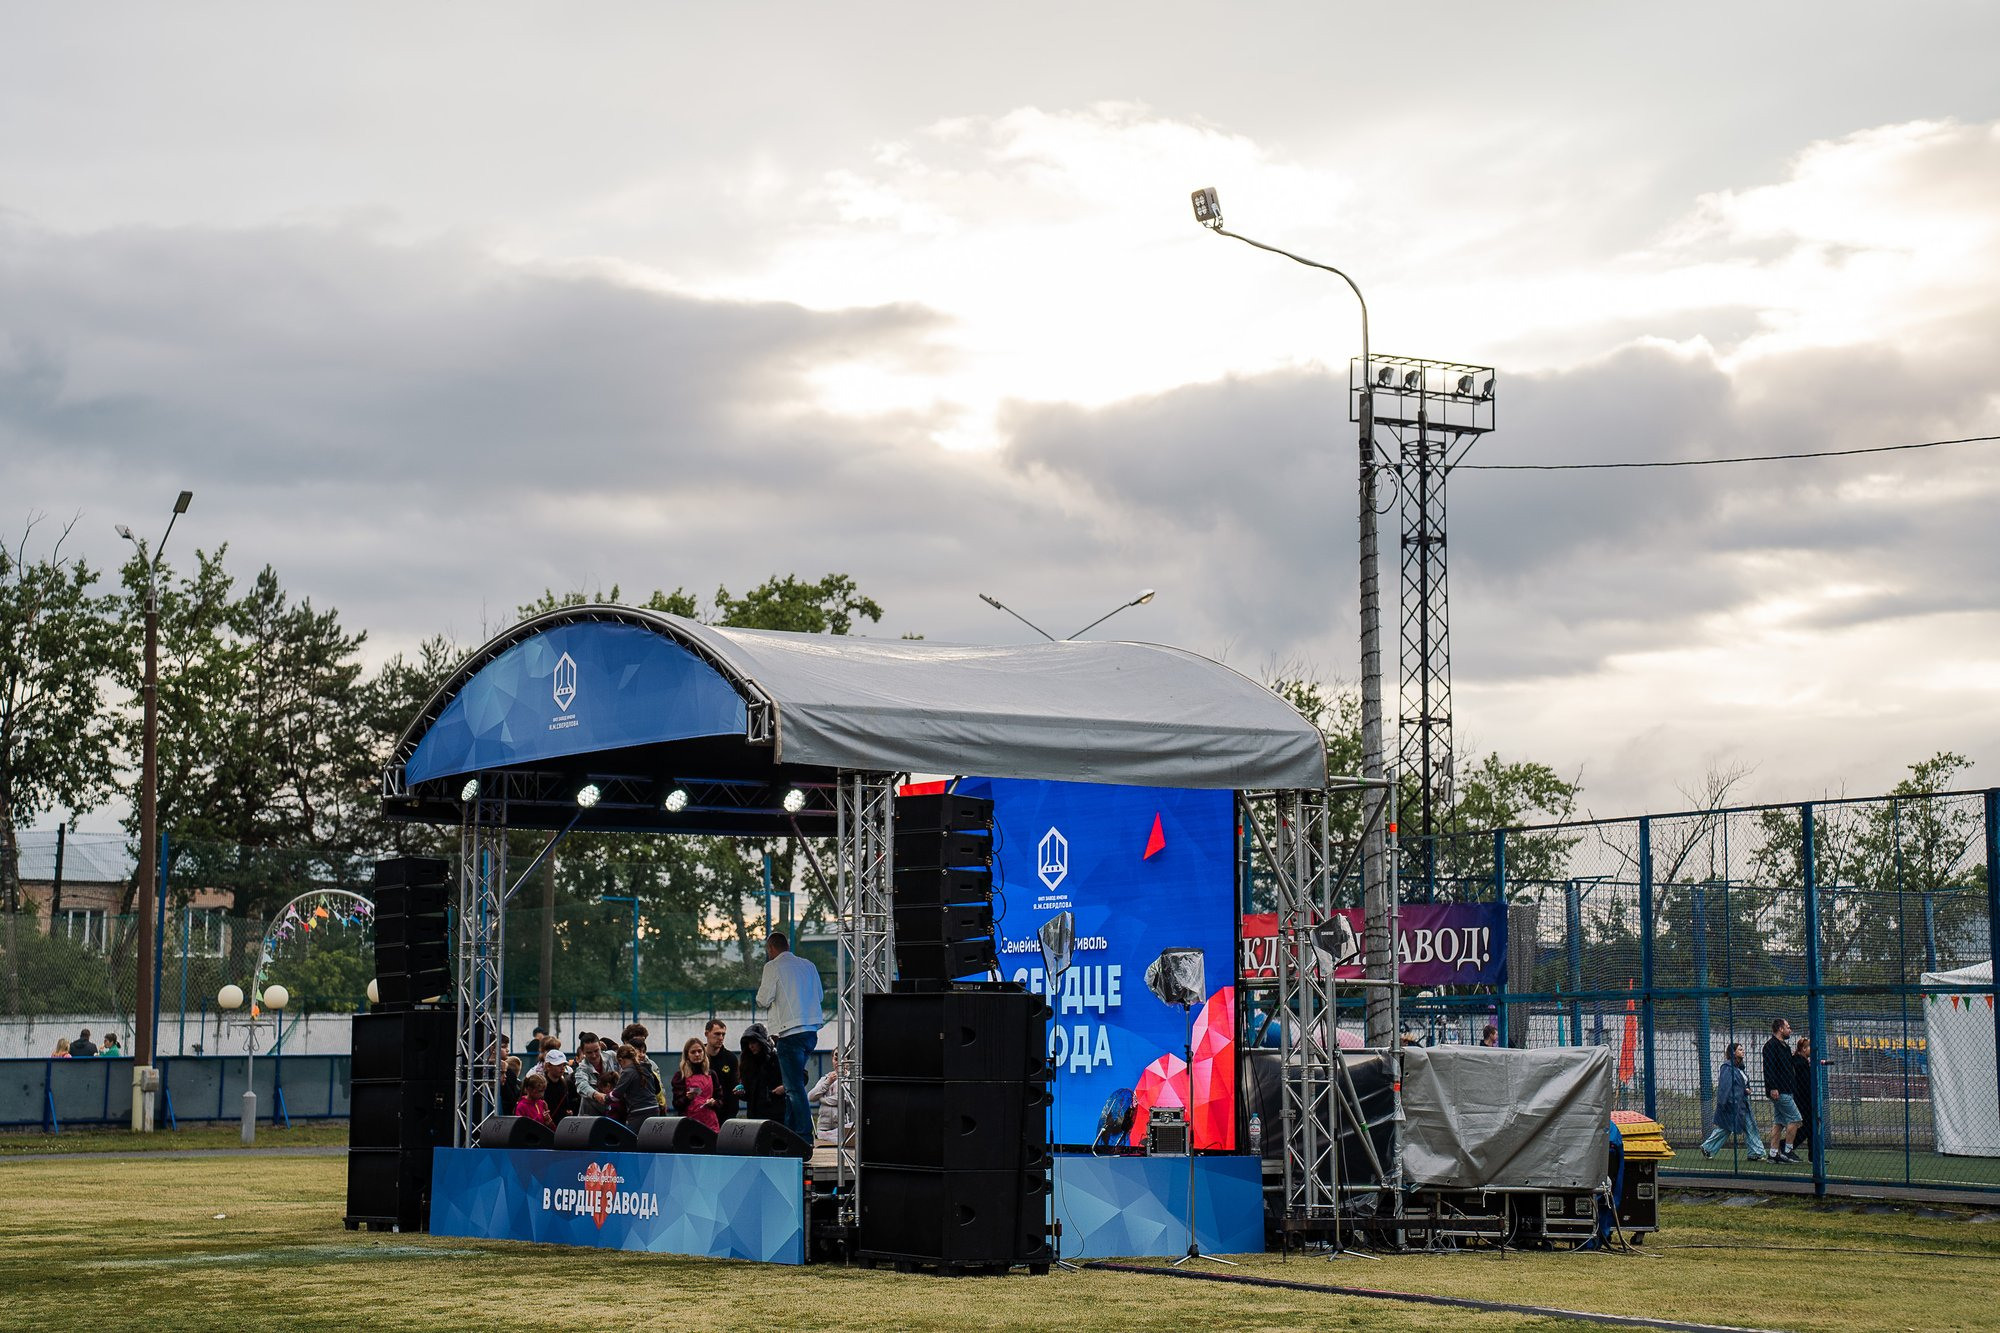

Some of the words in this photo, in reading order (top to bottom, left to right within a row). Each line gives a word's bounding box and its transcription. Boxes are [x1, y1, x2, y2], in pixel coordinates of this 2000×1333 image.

[1388, 926, 1490, 972] АВОД!
[542, 1187, 551, 1210] В
[554, 1188, 602, 1216] СЕРДЦЕ
[605, 1191, 659, 1220] ЗАВОДА
